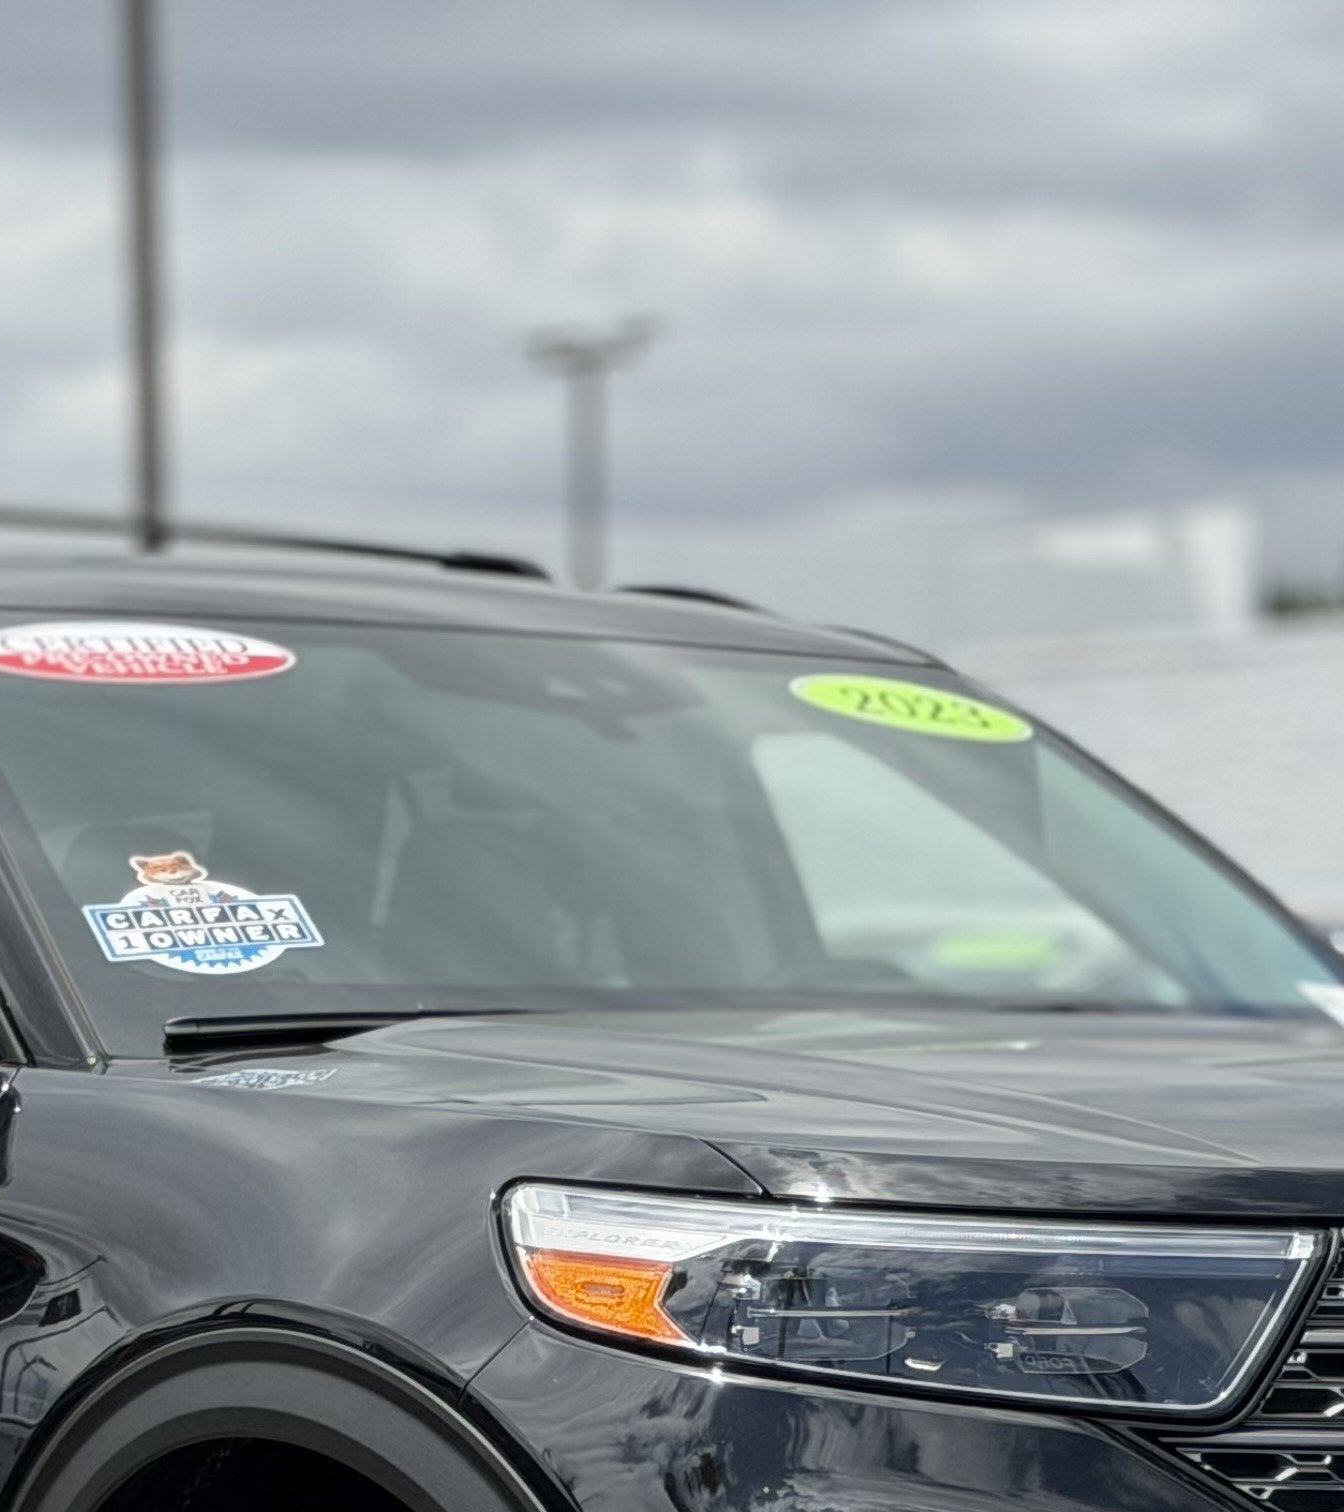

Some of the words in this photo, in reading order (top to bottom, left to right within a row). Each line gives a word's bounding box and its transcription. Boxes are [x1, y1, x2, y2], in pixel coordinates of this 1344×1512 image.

[64, 659, 229, 676] VEHICLE
[838, 686, 992, 729] 2023
[105, 904, 290, 930] CARFAX
[116, 930, 140, 950] 1
[148, 923, 302, 949] OWNER
